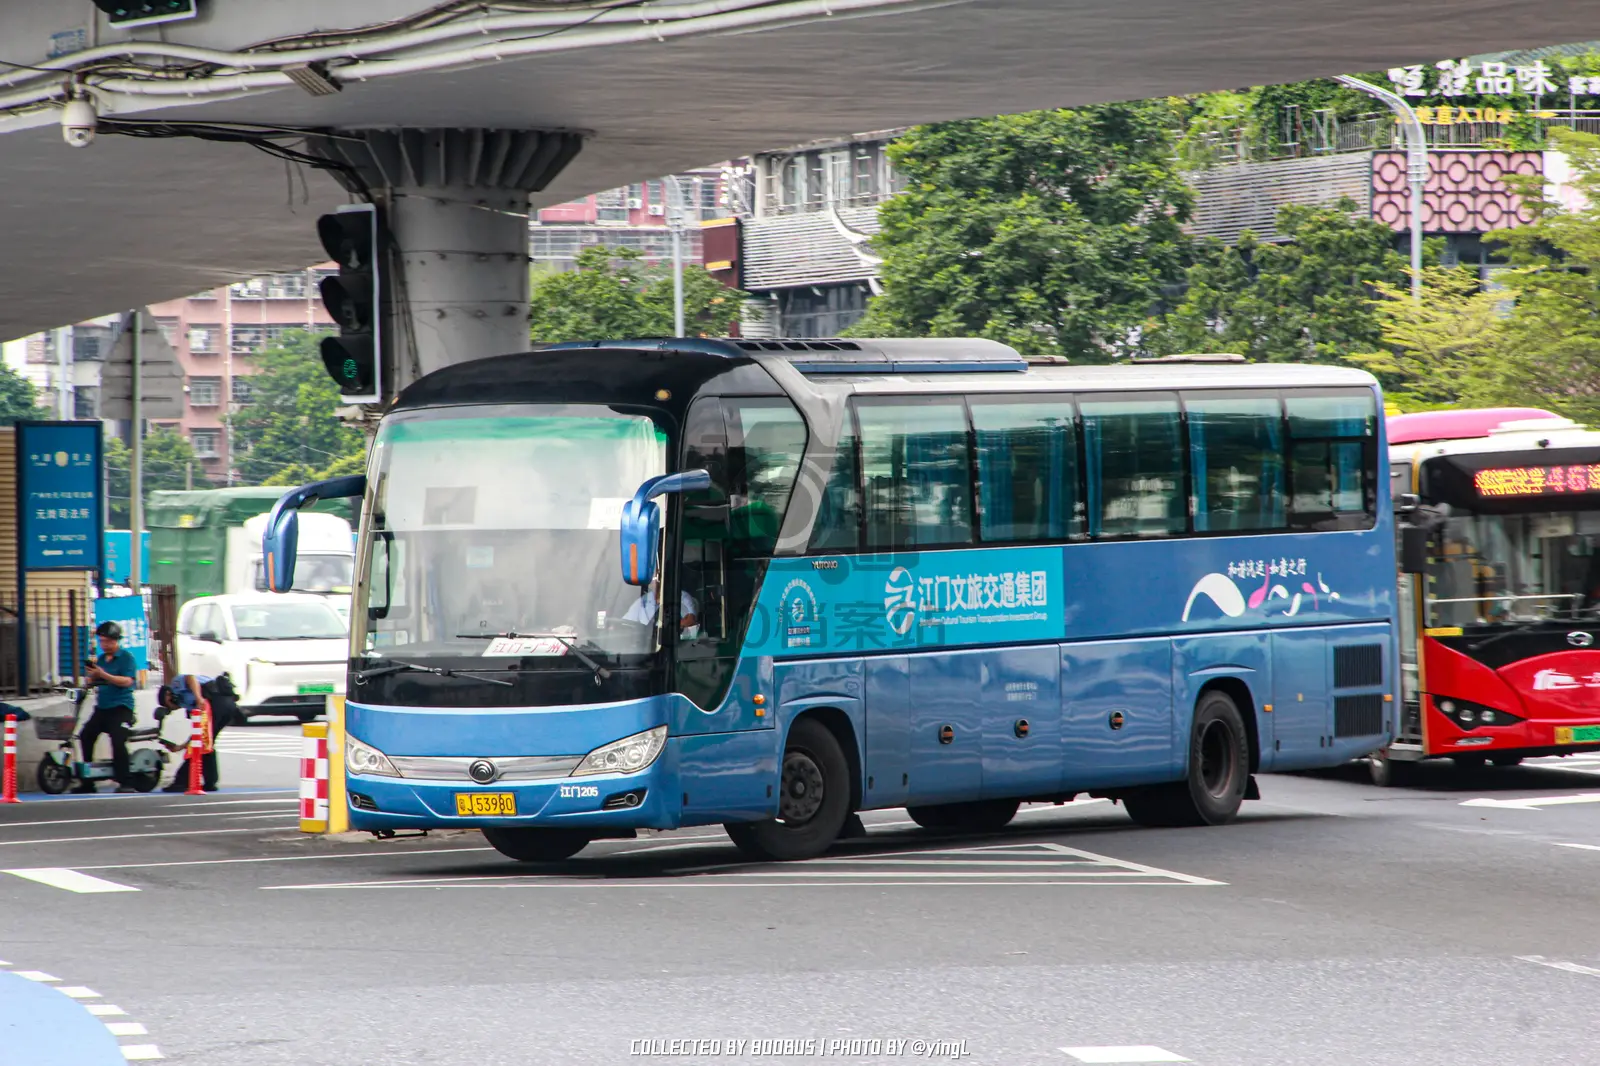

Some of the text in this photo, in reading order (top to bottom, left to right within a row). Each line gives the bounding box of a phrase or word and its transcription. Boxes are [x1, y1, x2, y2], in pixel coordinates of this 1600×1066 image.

[917, 571, 1047, 611] 江门文旅交通集团
[561, 786, 598, 797] 江门205
